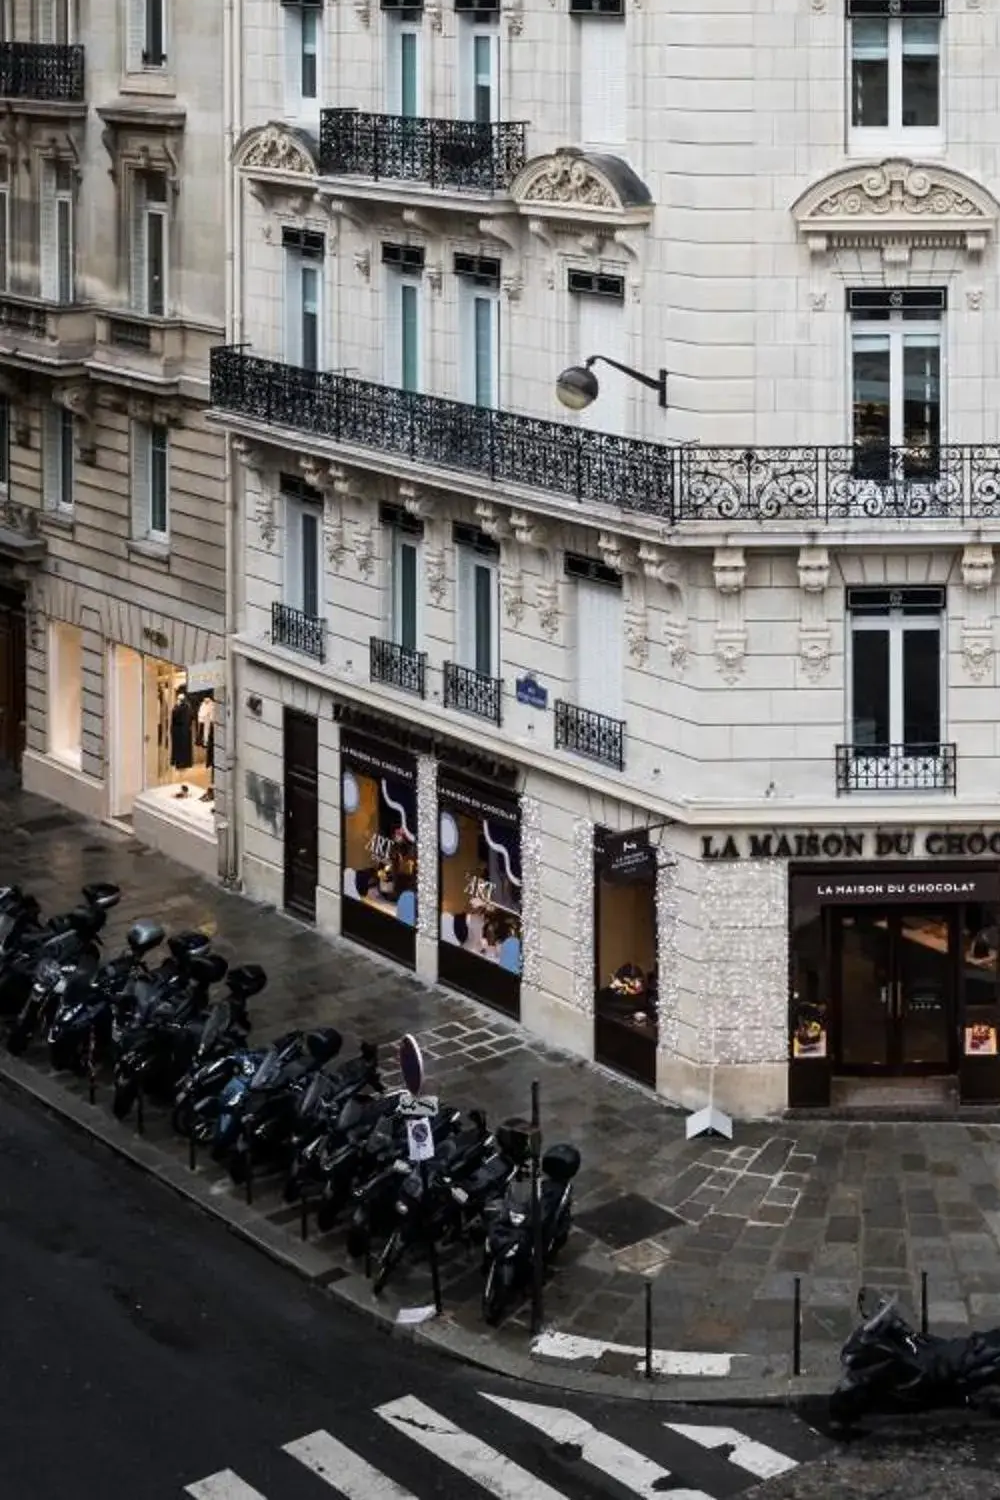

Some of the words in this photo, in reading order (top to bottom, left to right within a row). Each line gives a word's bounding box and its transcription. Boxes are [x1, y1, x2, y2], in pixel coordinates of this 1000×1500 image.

[701, 834, 741, 860] LA
[748, 832, 865, 859] MAISON
[875, 832, 915, 856] DU
[817, 884, 833, 895] LA
[835, 884, 883, 895] MAISON
[887, 883, 905, 894] DU
[908, 882, 976, 894] CHOCOLAT
